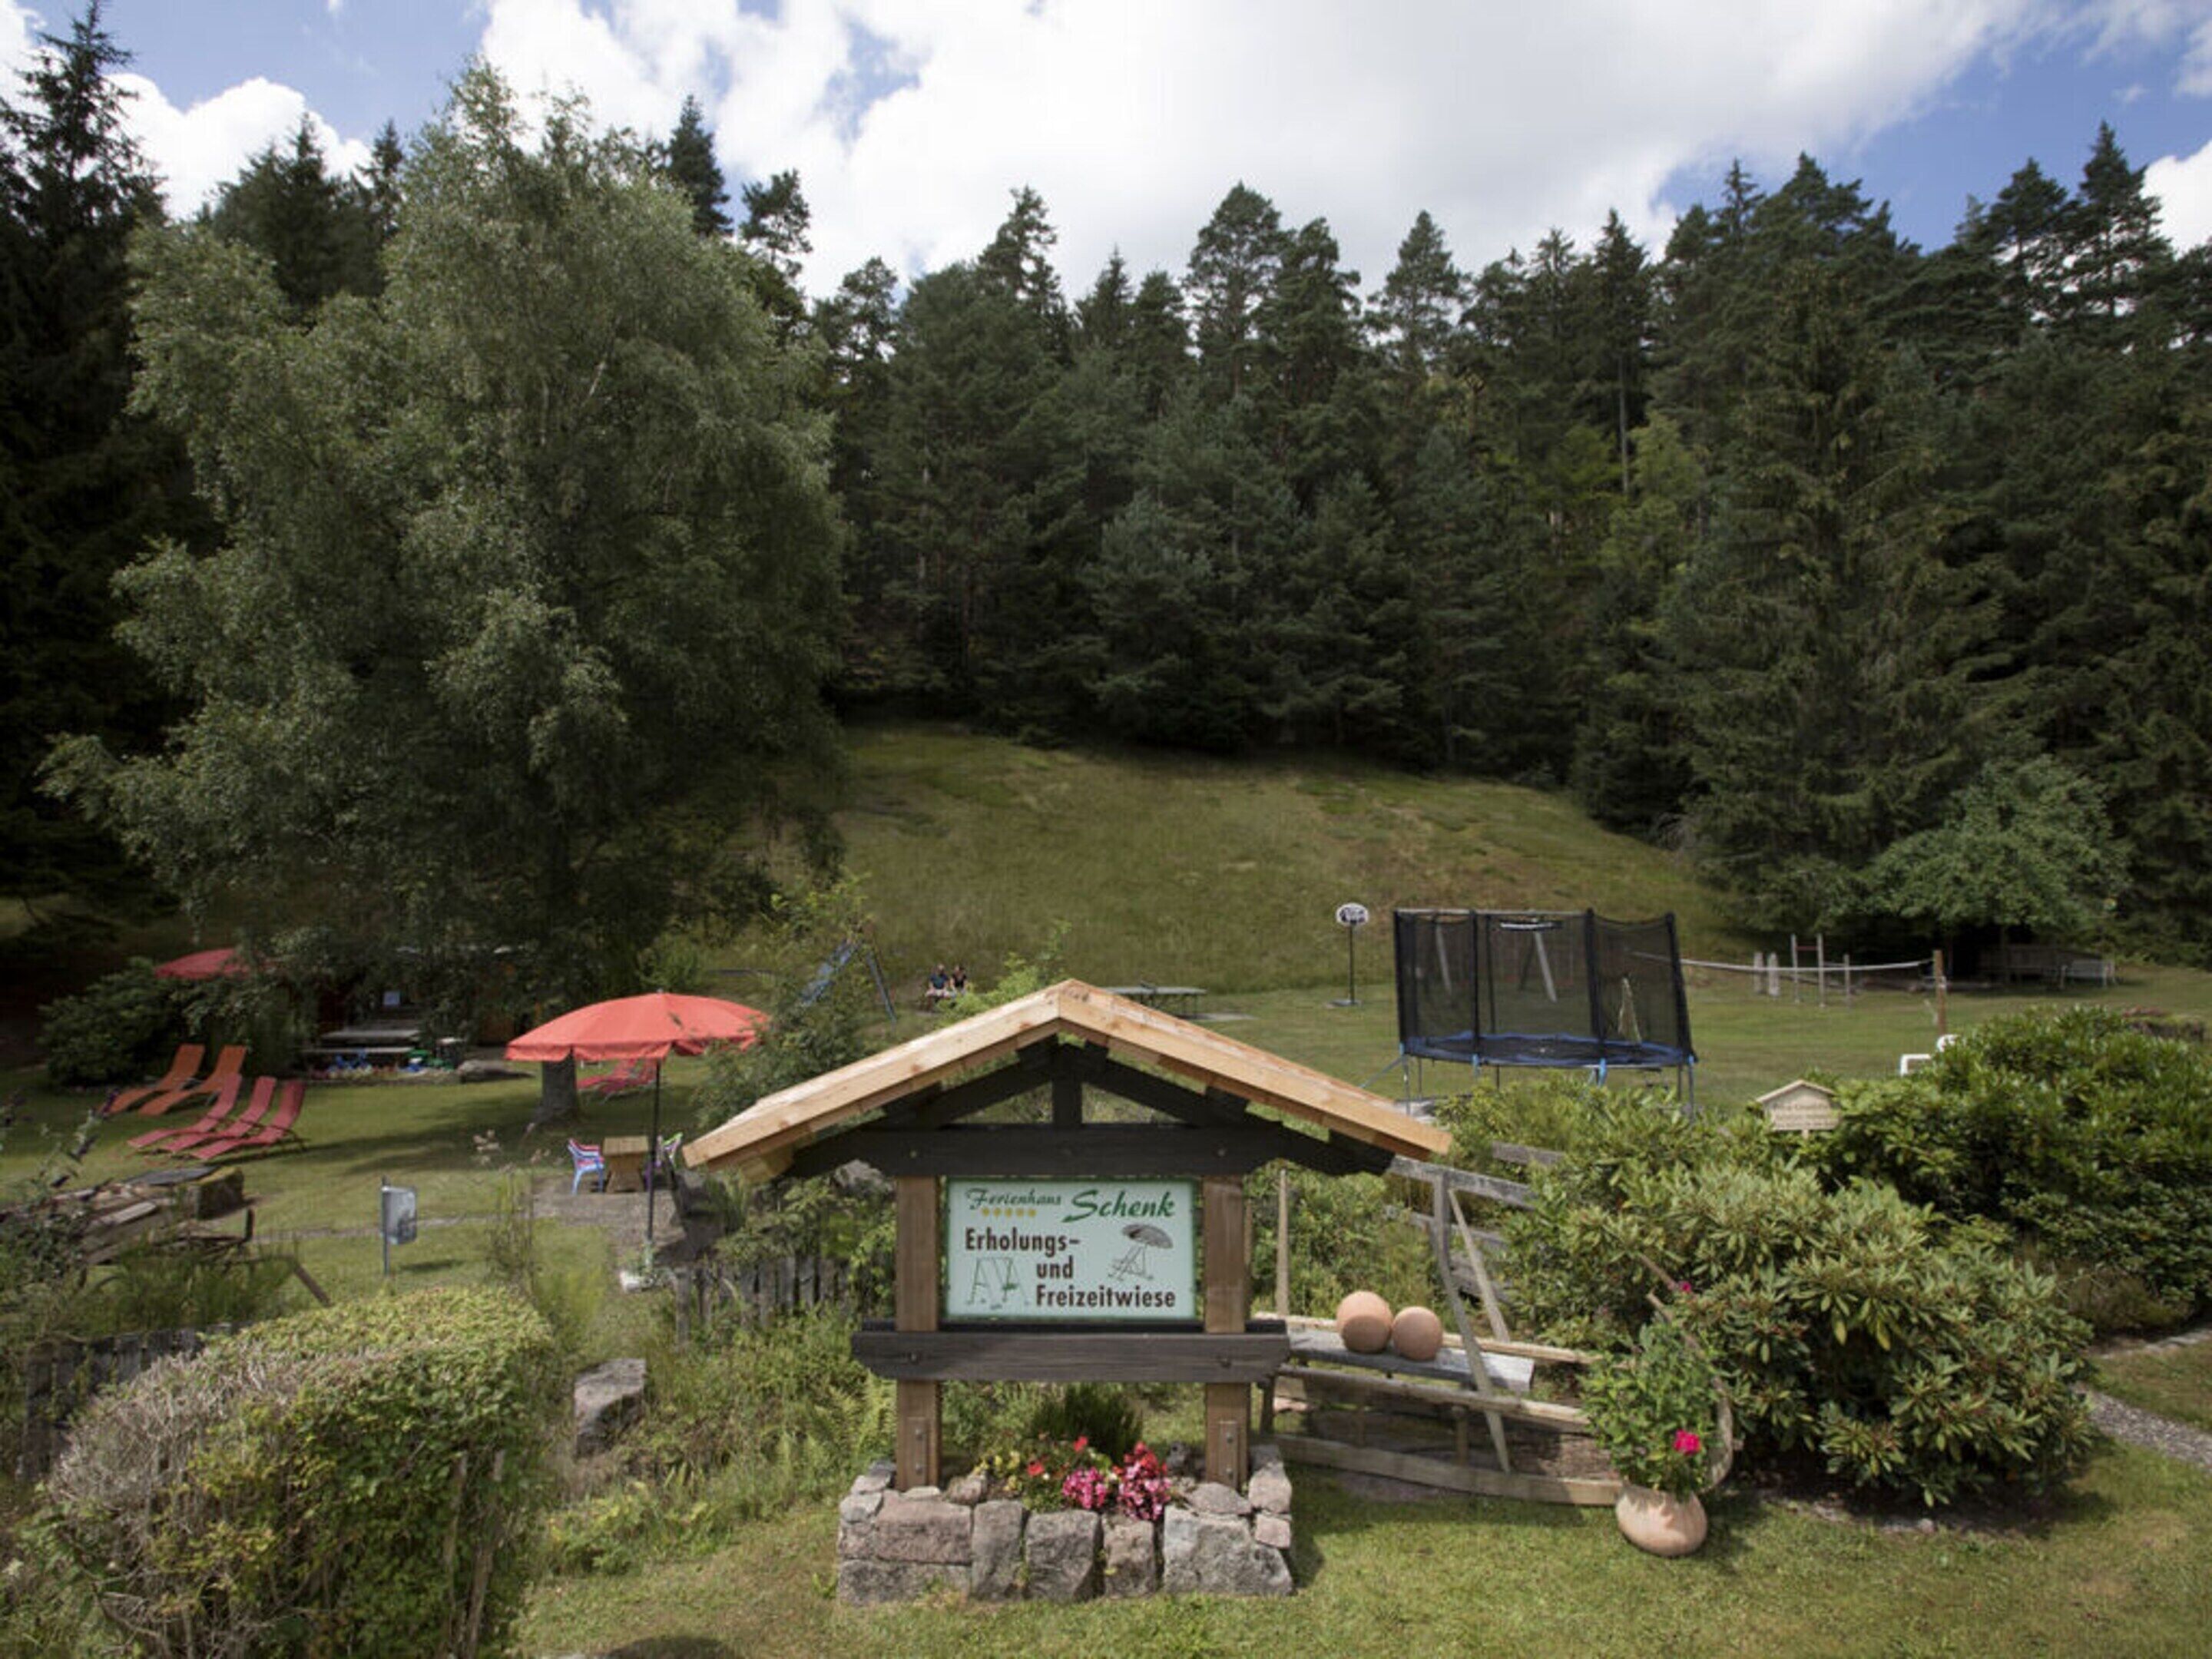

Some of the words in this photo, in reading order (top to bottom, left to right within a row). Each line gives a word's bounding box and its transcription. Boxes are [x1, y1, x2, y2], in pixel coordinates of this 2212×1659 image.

[965, 1187, 1061, 1210] Ferienhaus
[1061, 1190, 1175, 1223] Schenk
[965, 1227, 1081, 1257] Erholungs-
[1037, 1256, 1074, 1279] und
[1037, 1285, 1176, 1307] Freizeitwiese
